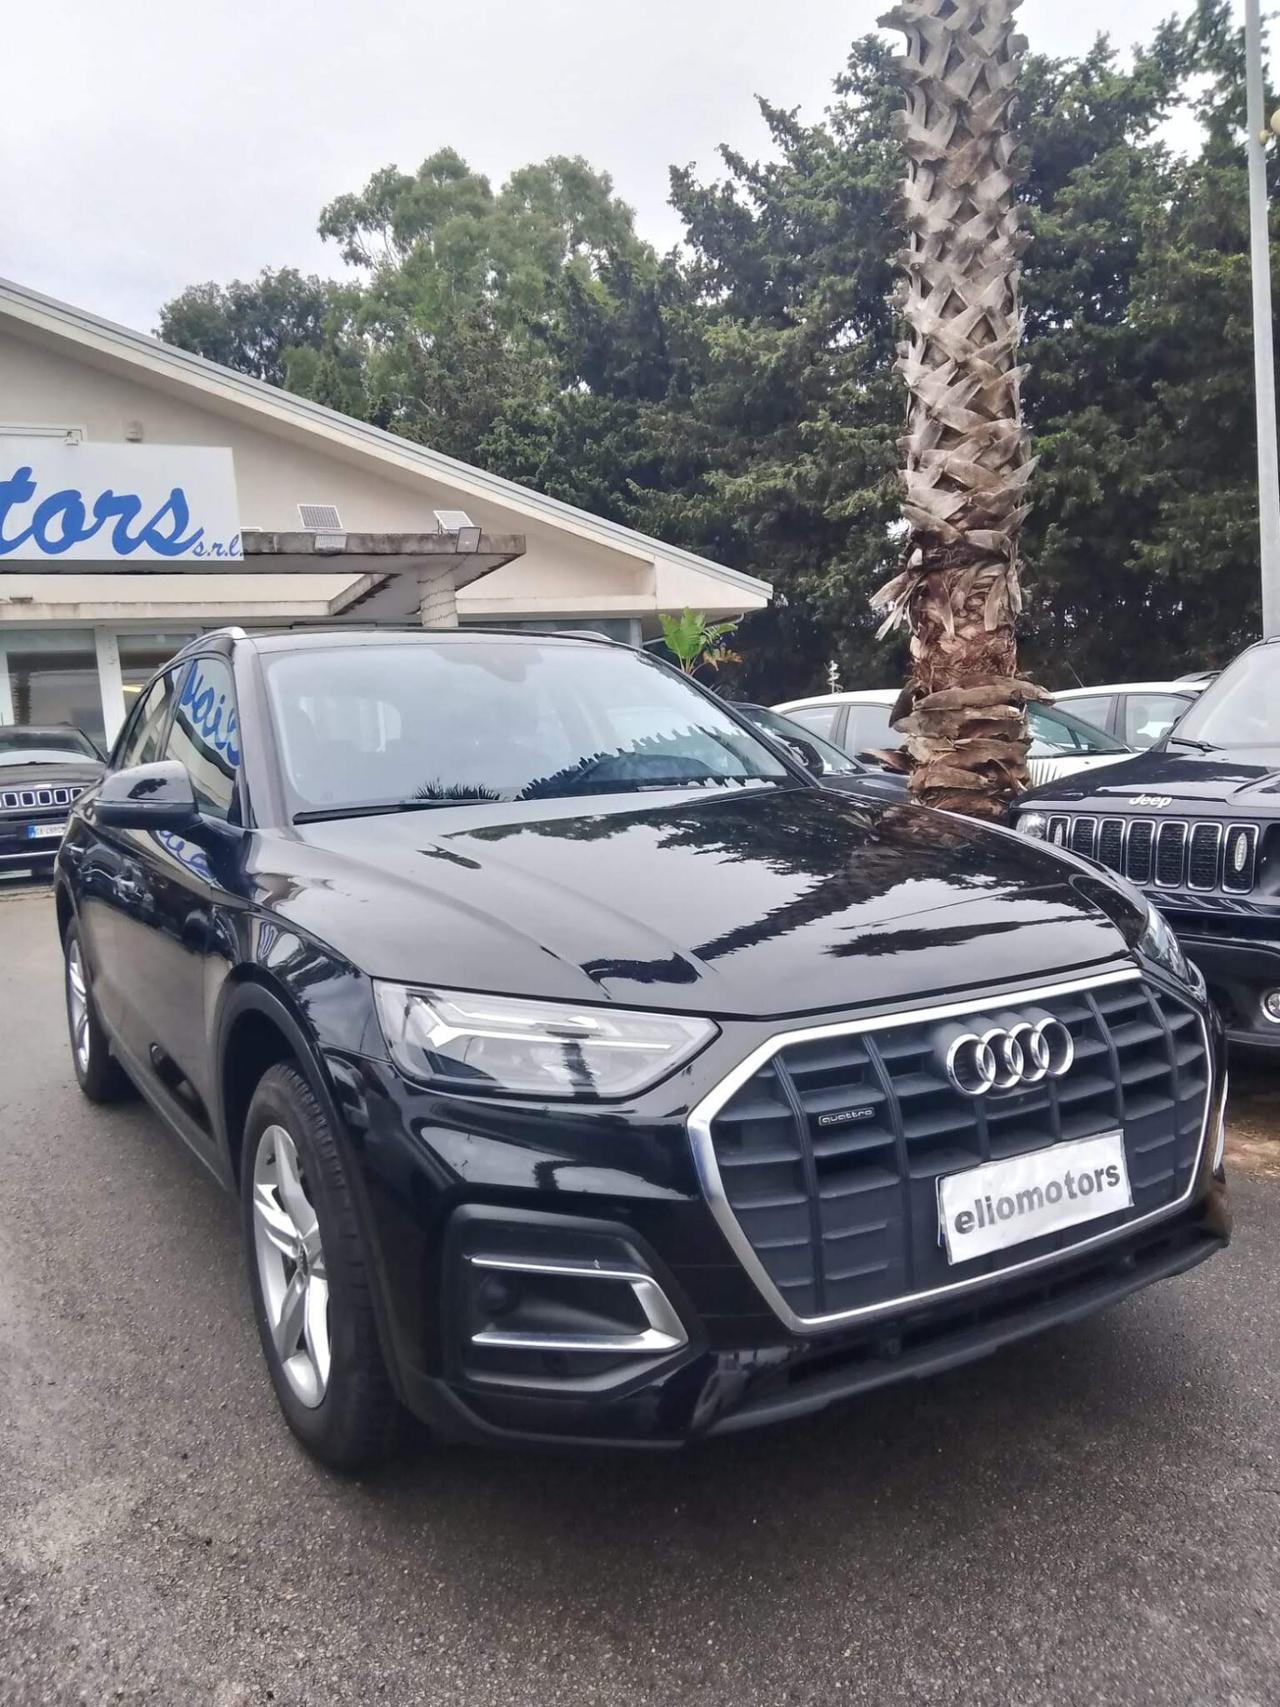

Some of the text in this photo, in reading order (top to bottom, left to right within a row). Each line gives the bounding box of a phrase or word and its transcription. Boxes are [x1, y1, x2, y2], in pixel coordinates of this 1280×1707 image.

[1129, 793, 1173, 809] Jeep
[821, 1109, 873, 1125] quattro
[954, 1164, 1121, 1235] eliomotors
